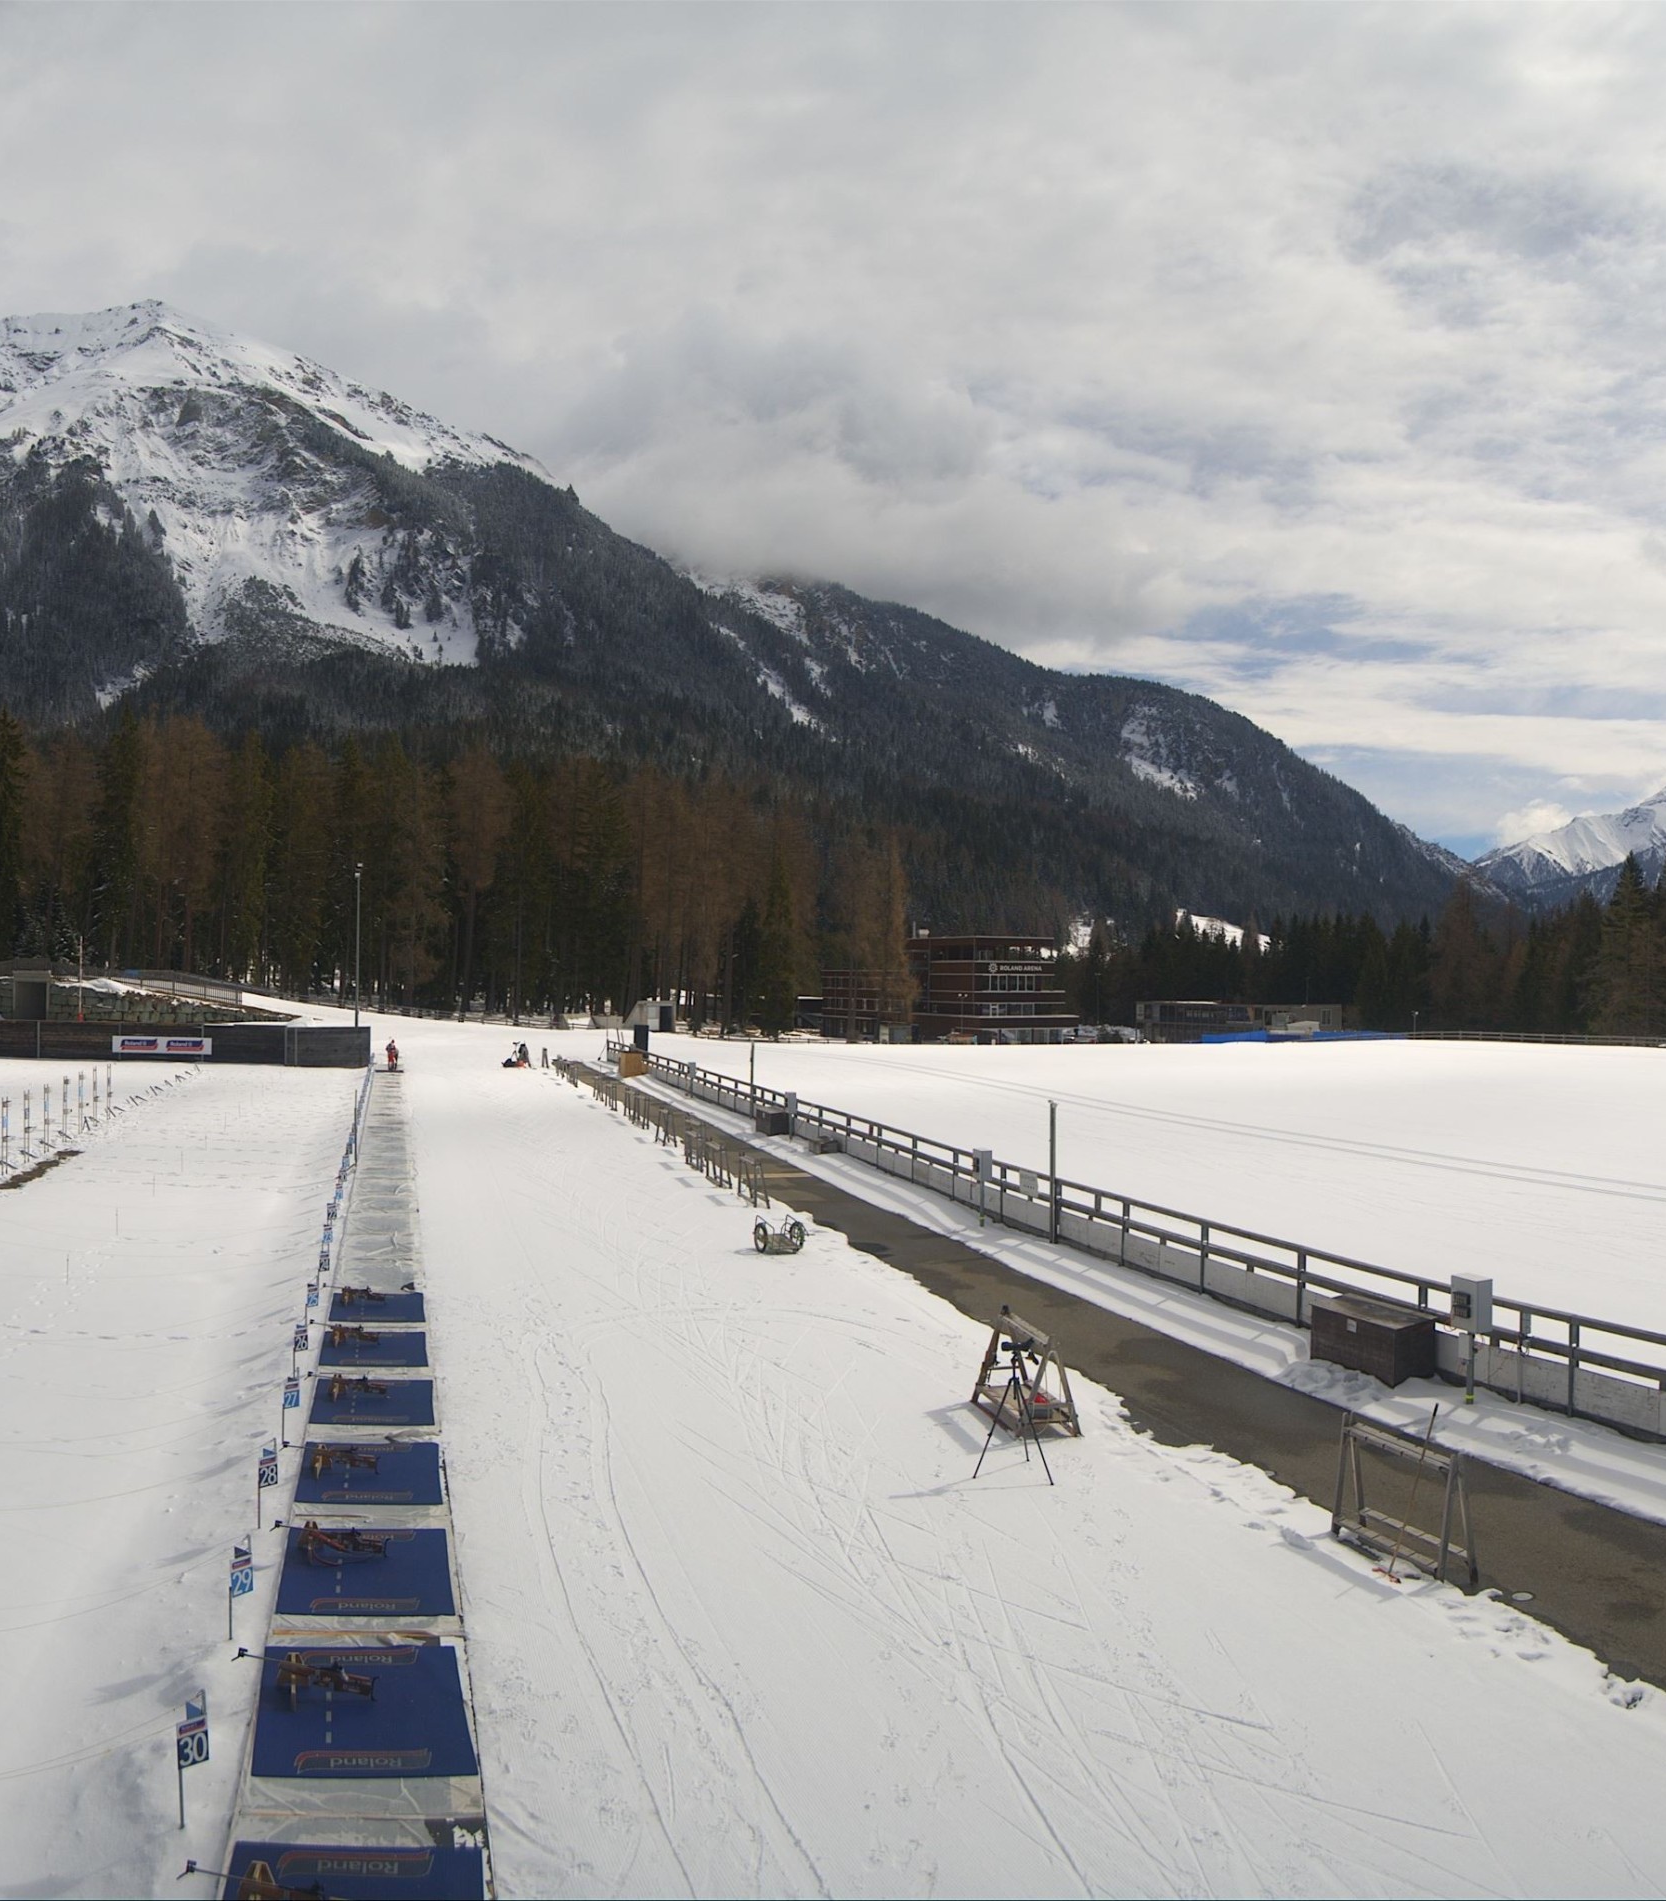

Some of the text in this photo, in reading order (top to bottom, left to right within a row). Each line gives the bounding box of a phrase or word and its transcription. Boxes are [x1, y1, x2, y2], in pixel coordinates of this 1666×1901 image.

[308, 1294, 318, 1307] 25
[295, 1336, 307, 1351] 26
[285, 1391, 299, 1407] 27
[260, 1466, 277, 1486] 28
[232, 1569, 252, 1596] 29
[330, 1655, 392, 1664] Roland
[179, 1732, 208, 1767] 30
[330, 1756, 402, 1767] Roland
[316, 1859, 399, 1874] Roland
